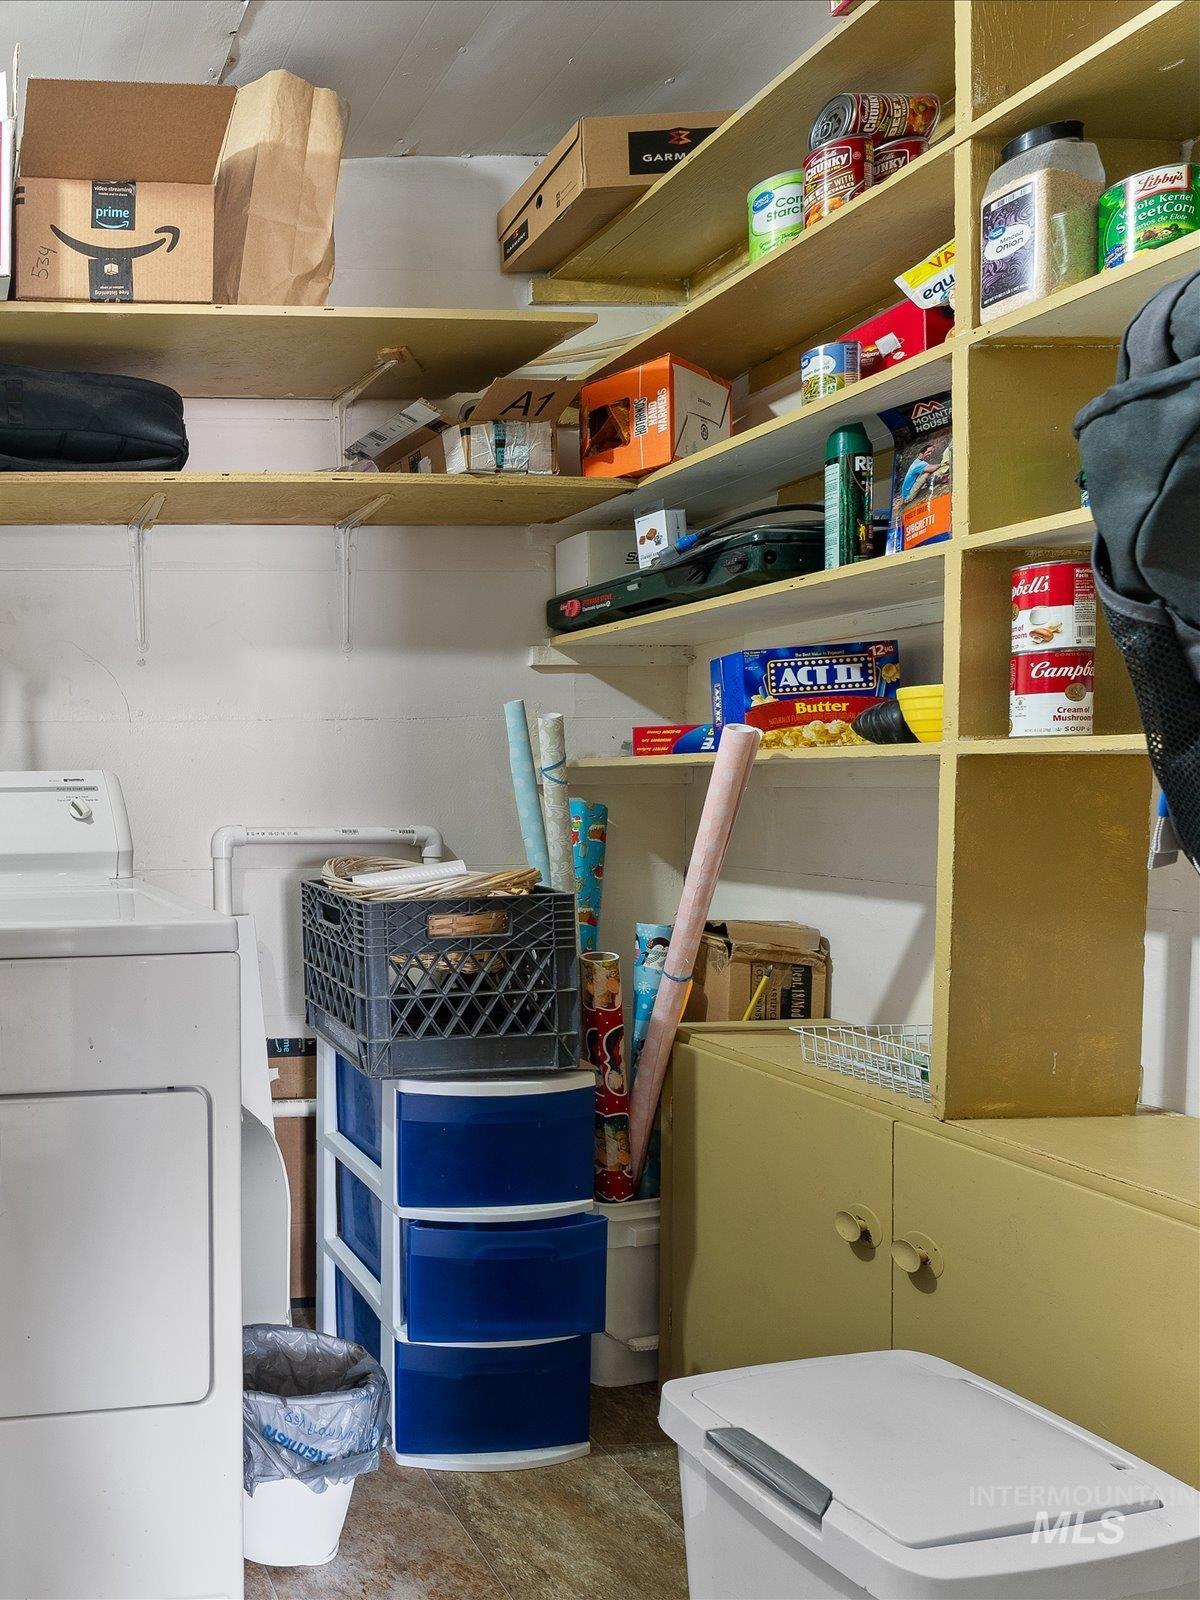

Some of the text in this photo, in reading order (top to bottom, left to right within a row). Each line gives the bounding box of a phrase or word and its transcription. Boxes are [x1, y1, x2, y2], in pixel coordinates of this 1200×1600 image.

[642, 152, 687, 162] GARM
[874, 157, 906, 175] UNKY
[805, 153, 849, 181] CHUNKY
[834, 173, 854, 187] WITH
[1136, 172, 1183, 194] Libby's
[108, 186, 132, 194] streaming
[96, 206, 130, 219] prime
[1119, 194, 1193, 219] Wole Kernel
[1157, 214, 1168, 222] de
[995, 237, 1024, 253] Onion
[999, 230, 1024, 244] Minced
[929, 249, 955, 268] VA
[95, 289, 118, 297] listening
[923, 274, 955, 299] equ
[498, 391, 555, 417] A1
[657, 388, 668, 433] WARMERS
[648, 401, 657, 426] HAND
[913, 408, 952, 426] MOUNTA
[915, 418, 949, 433] HOUSE
[906, 514, 935, 537] SPAGHETTI
[1012, 575, 1050, 601] pbell's
[869, 645, 885, 656] 12
[779, 663, 864, 687] ACT II
[1030, 661, 1094, 680] Campbe
[795, 702, 850, 714] Butter
[1057, 706, 1083, 714] Cream
[1052, 714, 1092, 722] Mushroom
[791, 967, 805, 988] Dept.
[769, 988, 778, 1020] ARTIFICI
